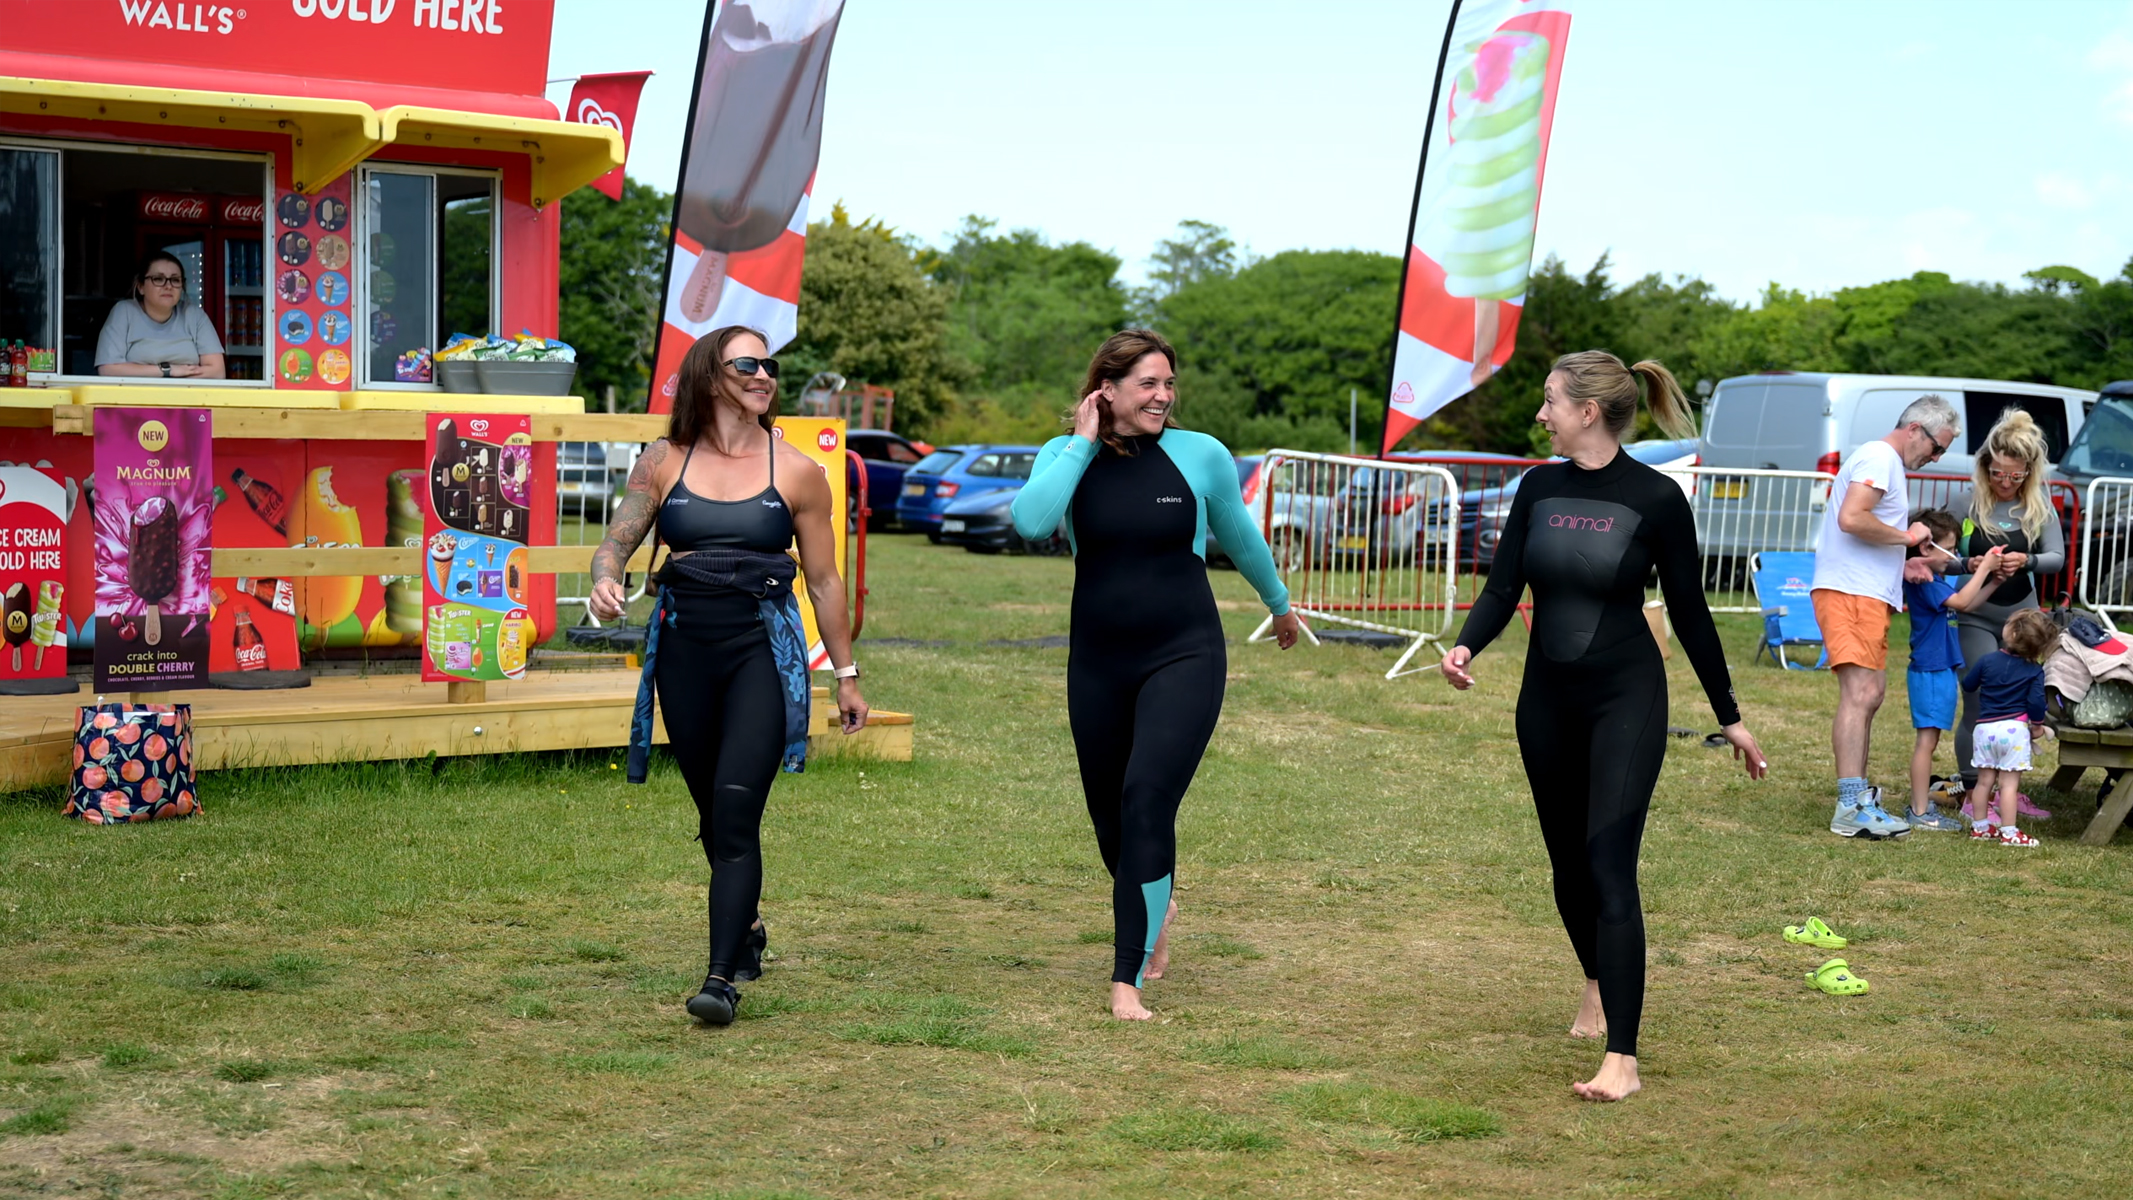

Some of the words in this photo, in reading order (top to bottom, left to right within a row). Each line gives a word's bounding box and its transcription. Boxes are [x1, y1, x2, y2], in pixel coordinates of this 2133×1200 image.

[413, 0, 504, 35] HERE
[144, 196, 203, 219] Coca-Cola
[142, 431, 165, 441] NEW
[819, 434, 837, 446] NEW
[116, 465, 192, 480] MAGNUM
[1548, 514, 1615, 533] animal
[14, 528, 61, 547] CREAM
[0, 551, 25, 570] OLD
[30, 551, 61, 570] HERE
[274, 580, 294, 613] Coke
[126, 651, 154, 661] crack
[157, 651, 178, 660] into
[236, 643, 267, 663] Coca-Cola
[108, 663, 156, 674] DOUBLE
[157, 661, 195, 673] CHERRY
